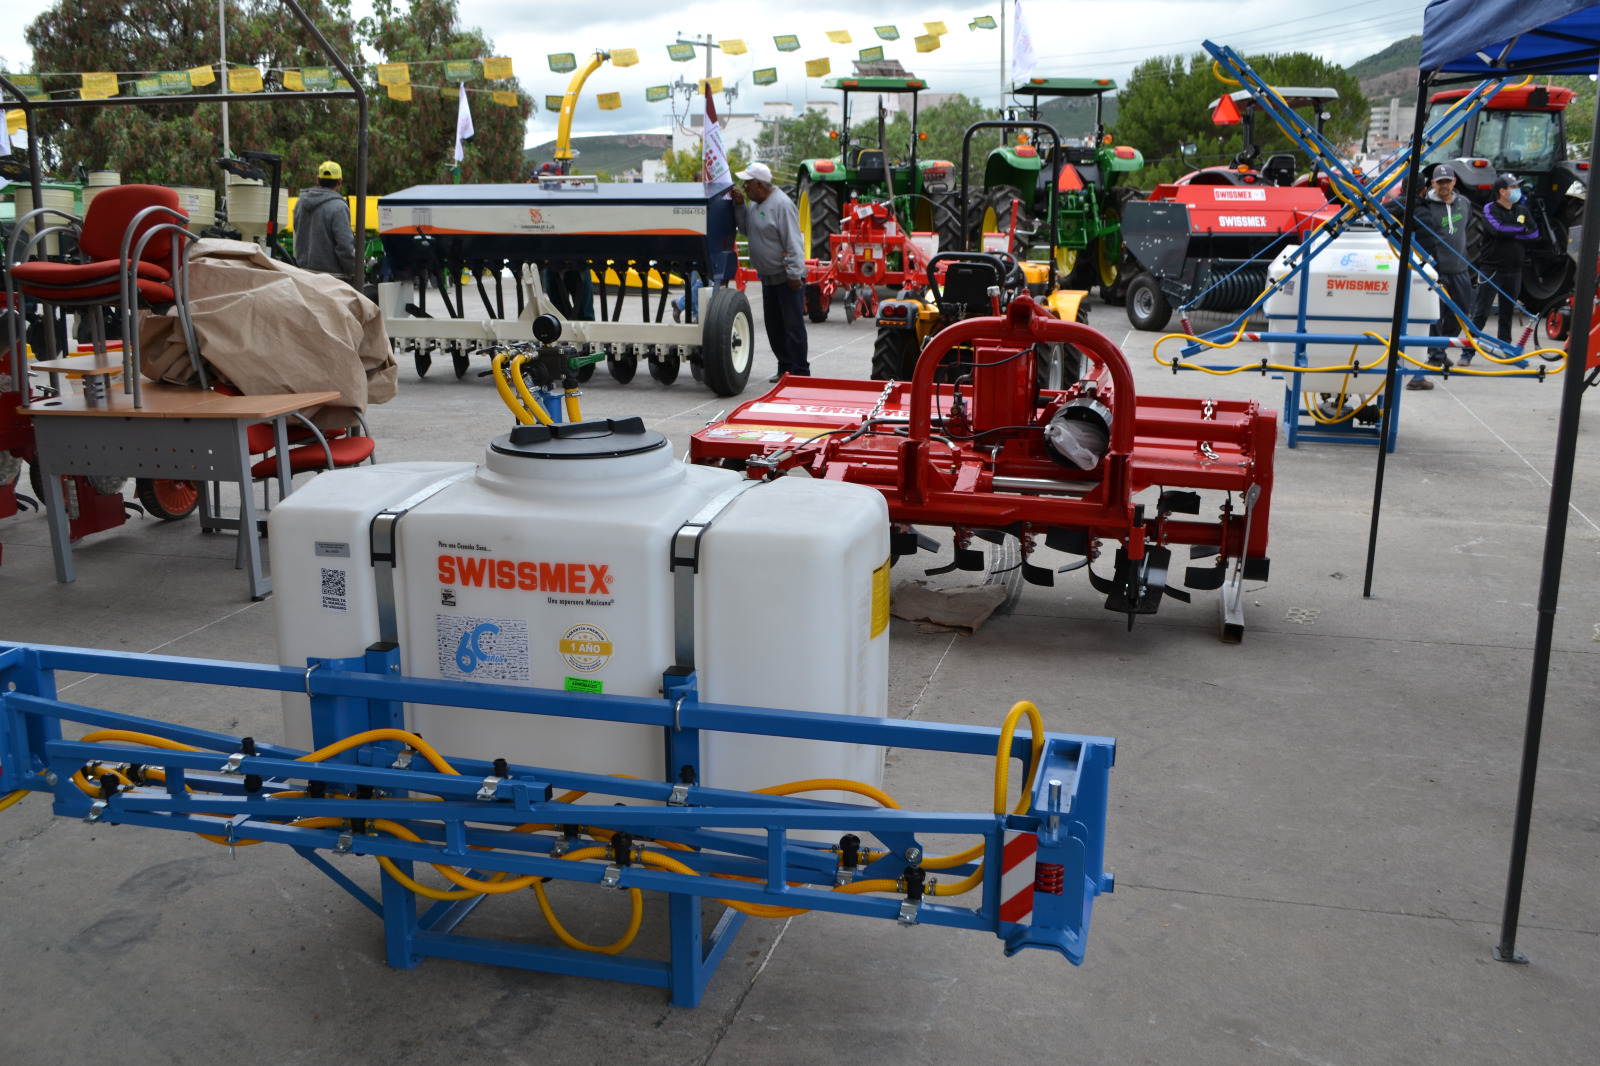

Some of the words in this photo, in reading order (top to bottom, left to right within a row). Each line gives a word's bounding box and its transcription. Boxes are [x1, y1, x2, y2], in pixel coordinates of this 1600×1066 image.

[1215, 190, 1252, 199] SWISSMEX
[1218, 215, 1266, 227] SWISSMEX
[1326, 279, 1389, 292] SWISSMEX
[547, 596, 558, 604] Una
[586, 627, 605, 641] PREMIUM
[570, 642, 576, 651] 1
[578, 641, 601, 653] AÑO
